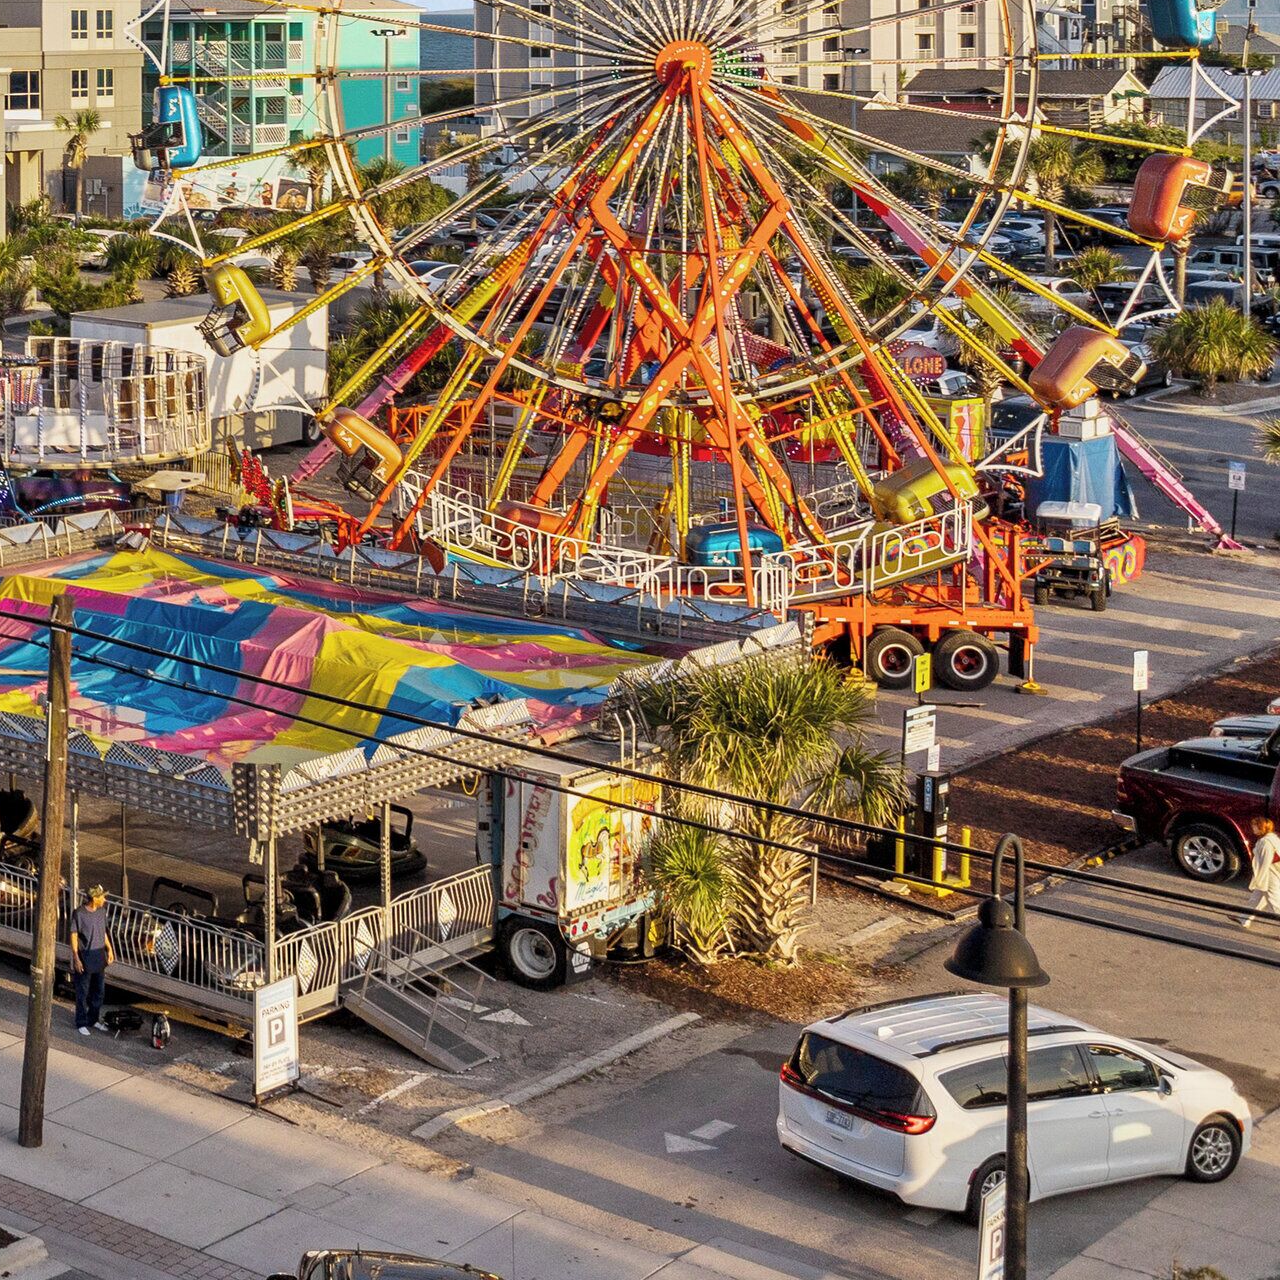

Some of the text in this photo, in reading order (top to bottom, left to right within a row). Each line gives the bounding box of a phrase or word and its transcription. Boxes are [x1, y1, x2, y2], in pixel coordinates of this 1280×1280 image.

[261, 1000, 290, 1019] PARKING
[270, 1018, 283, 1045] P
[992, 1228, 1003, 1260] P
